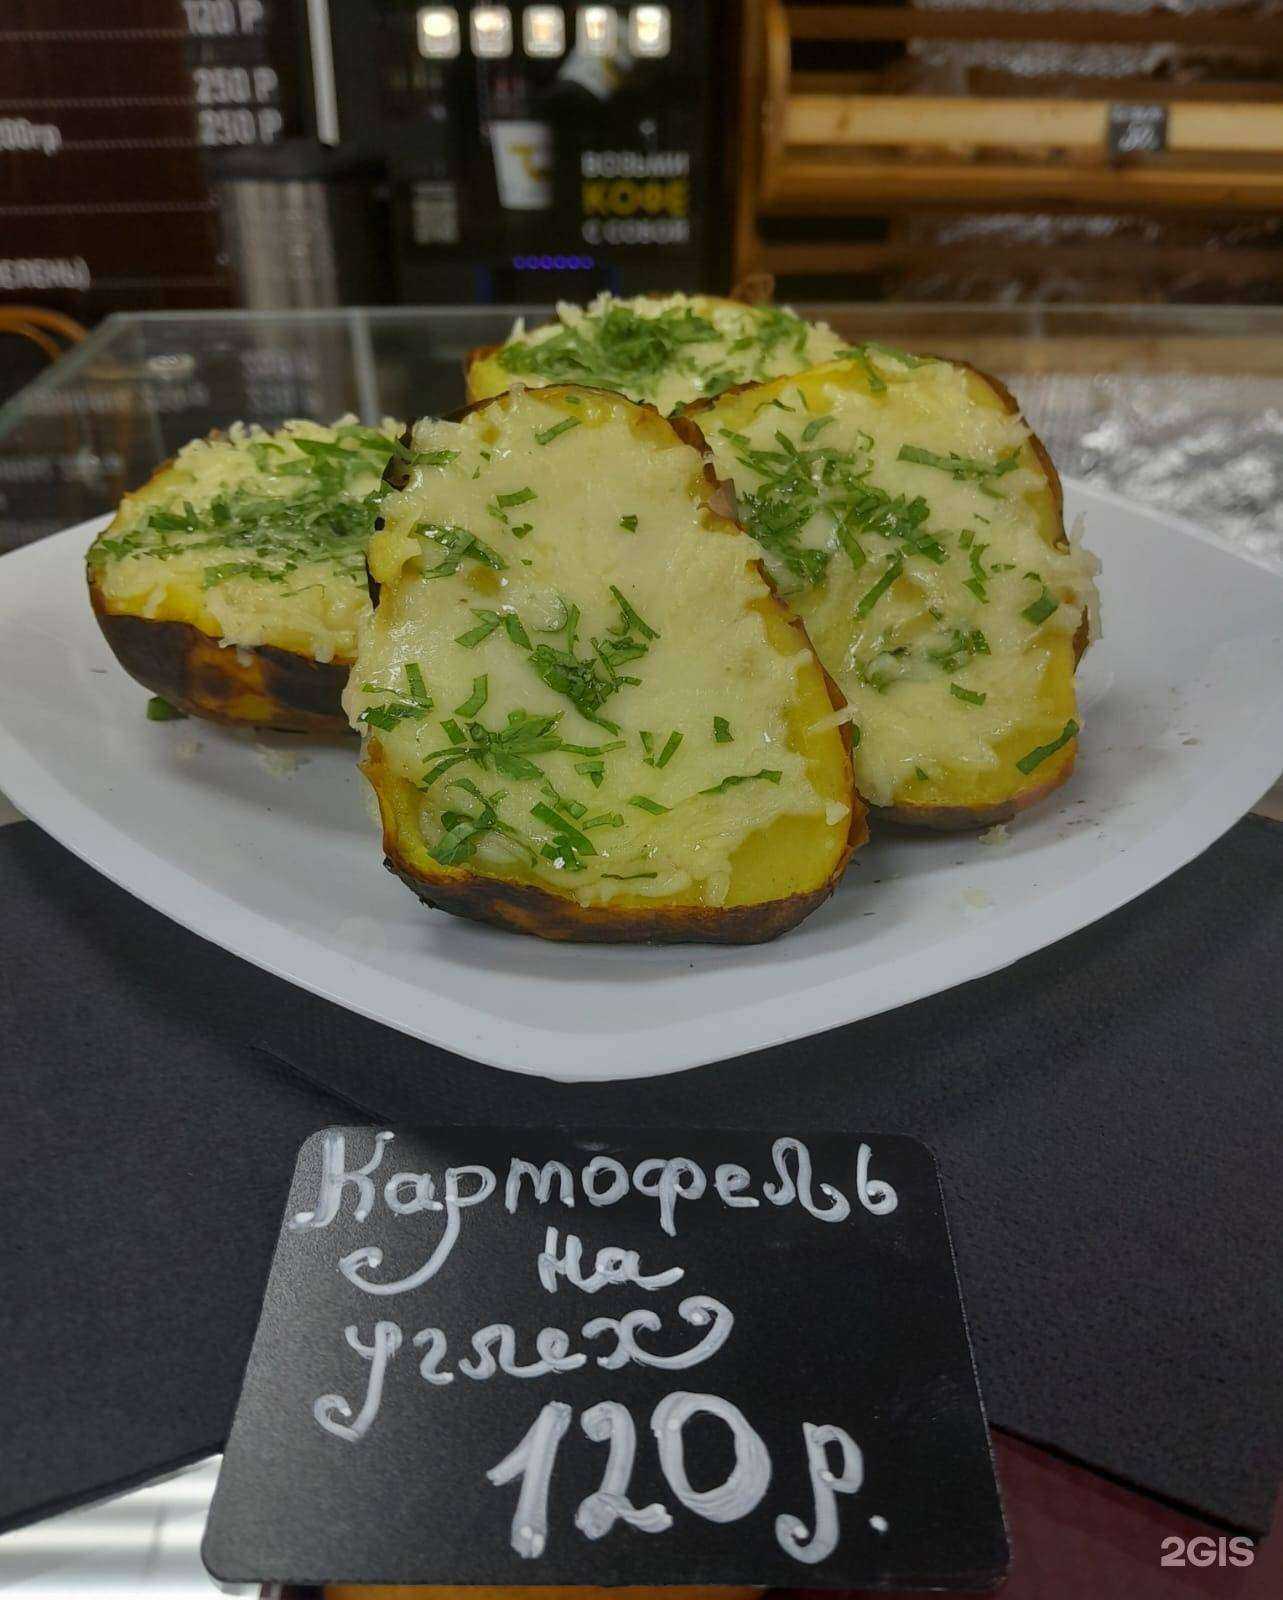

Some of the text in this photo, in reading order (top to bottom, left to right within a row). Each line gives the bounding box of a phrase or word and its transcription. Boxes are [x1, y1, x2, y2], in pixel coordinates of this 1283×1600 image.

[581, 180, 687, 217] КОФЕ
[290, 1131, 899, 1296] Картофель
[485, 1390, 773, 1559] 120
